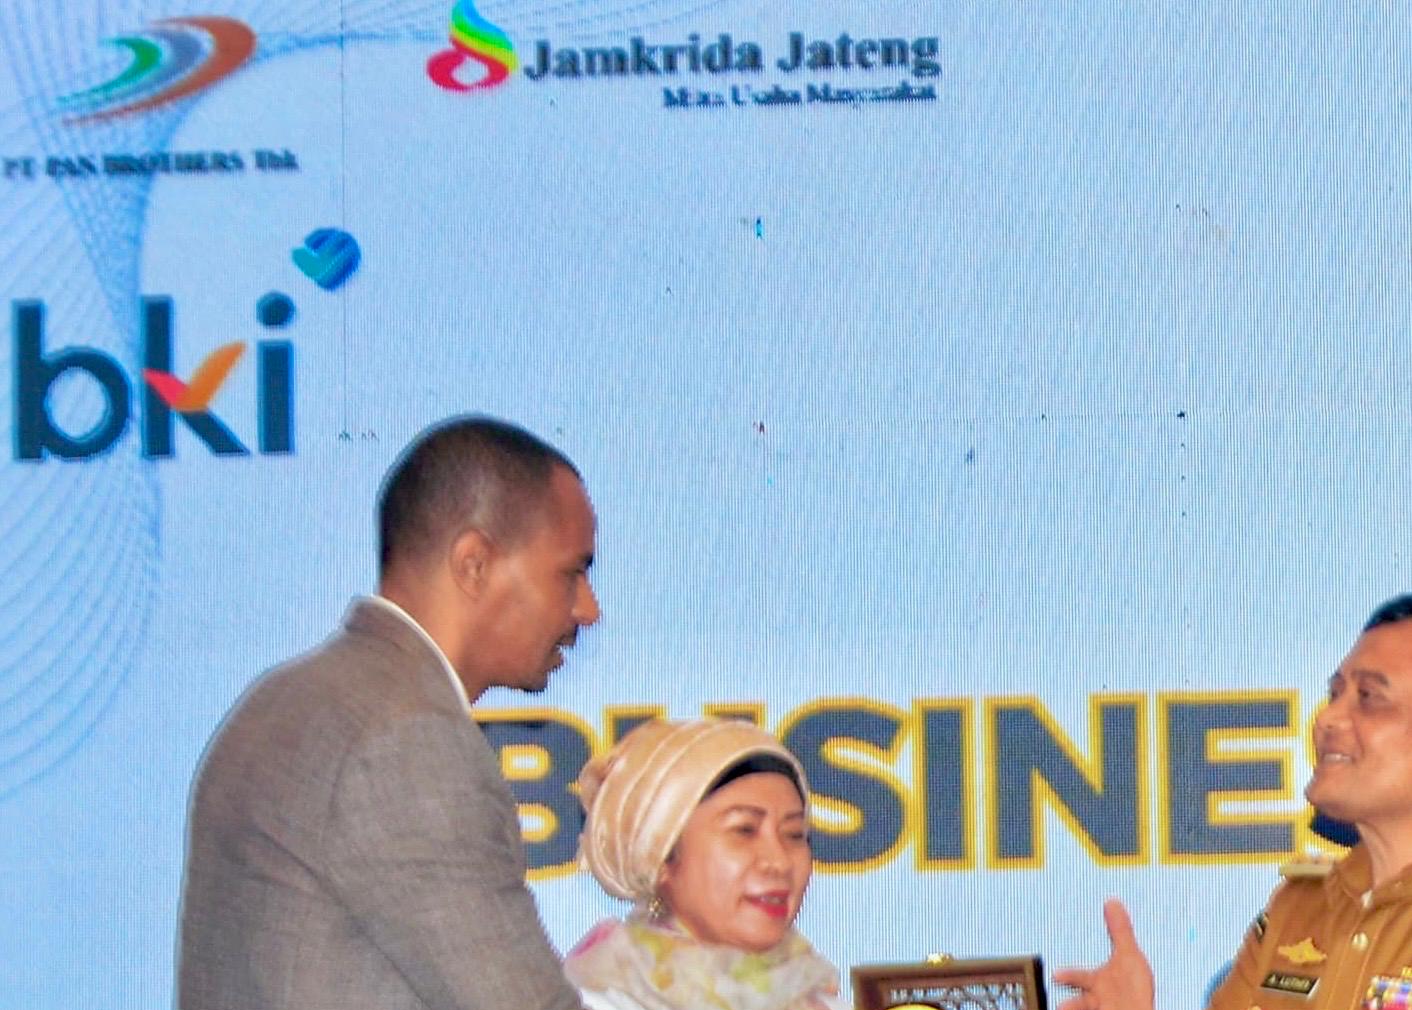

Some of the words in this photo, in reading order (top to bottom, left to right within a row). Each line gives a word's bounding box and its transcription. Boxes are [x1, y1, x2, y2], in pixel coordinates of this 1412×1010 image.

[523, 33, 764, 81] Jamkrida
[777, 31, 941, 79] Jateng
[4, 157, 34, 179] PT
[46, 155, 97, 179] PAN
[103, 151, 244, 176] BROTHERS
[11, 290, 297, 462] bki
